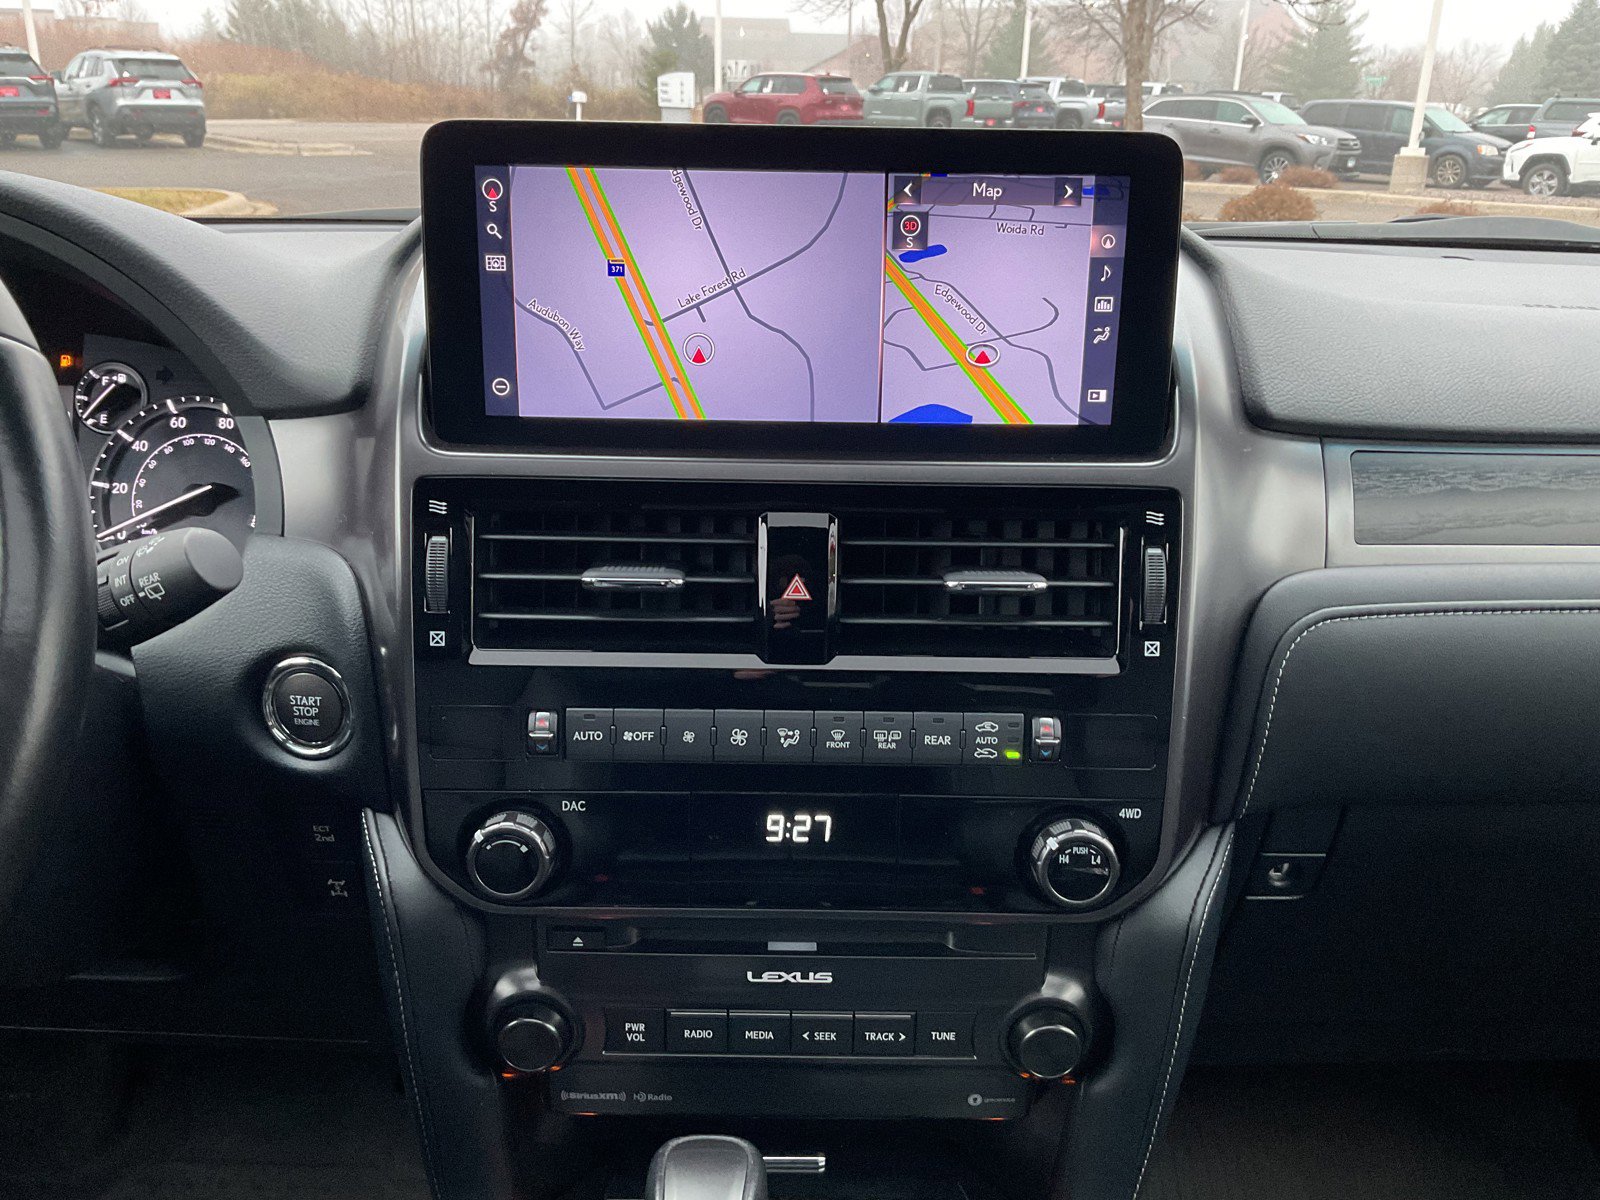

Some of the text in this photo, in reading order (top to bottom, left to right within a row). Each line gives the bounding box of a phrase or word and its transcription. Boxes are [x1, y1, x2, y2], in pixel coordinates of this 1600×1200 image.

[972, 183, 1003, 200] Map
[490, 201, 497, 213] S
[691, 216, 703, 230] Dr
[904, 221, 918, 231] 3D
[996, 222, 1045, 236] Woida Rd
[906, 237, 914, 247] S
[611, 265, 623, 274] 371
[678, 268, 746, 308] Lake Forest Rd
[934, 284, 988, 335] Edgewood Dr
[527, 298, 586, 352] Audubon Way
[102, 377, 109, 386] F
[100, 414, 107, 424] E
[170, 417, 187, 429] 60
[218, 418, 235, 430] 80
[132, 440, 149, 452] 40
[182, 438, 195, 447] 100
[204, 438, 216, 446] 120
[163, 445, 174, 455] 80
[223, 443, 236, 454] 140
[148, 459, 157, 470] 60
[240, 456, 252, 468] 160
[138, 478, 147, 488] 40
[112, 483, 128, 495] 20
[135, 499, 143, 509] 20
[114, 575, 127, 588] INT
[138, 572, 161, 588] REAR
[120, 594, 135, 607] OFF
[289, 694, 322, 706] START
[292, 706, 319, 717] STOP
[294, 718, 320, 727] ENGINE
[573, 731, 603, 742] AUTO
[633, 731, 655, 742] OFF
[924, 735, 951, 746] REAR
[975, 736, 998, 745] AUTO
[826, 740, 851, 749] FRONT
[877, 741, 897, 749] REAR
[561, 800, 587, 812] DAC
[1118, 808, 1142, 820] 4WD
[765, 813, 833, 843] 9:27
[315, 833, 335, 843] 2nd
[1072, 846, 1092, 855] PUSH
[1058, 854, 1070, 865] H4
[1091, 854, 1101, 865] L4
[747, 970, 833, 984] LEXUS
[624, 1022, 646, 1032] PWR
[625, 1032, 646, 1042] VOL
[683, 1028, 713, 1039] RADIO
[744, 1030, 774, 1040] MEDIA
[814, 1031, 837, 1041] SEEK
[864, 1031, 895, 1042] TRACK
[930, 1031, 956, 1042] TUNE
[647, 1093, 673, 1101] Radio
